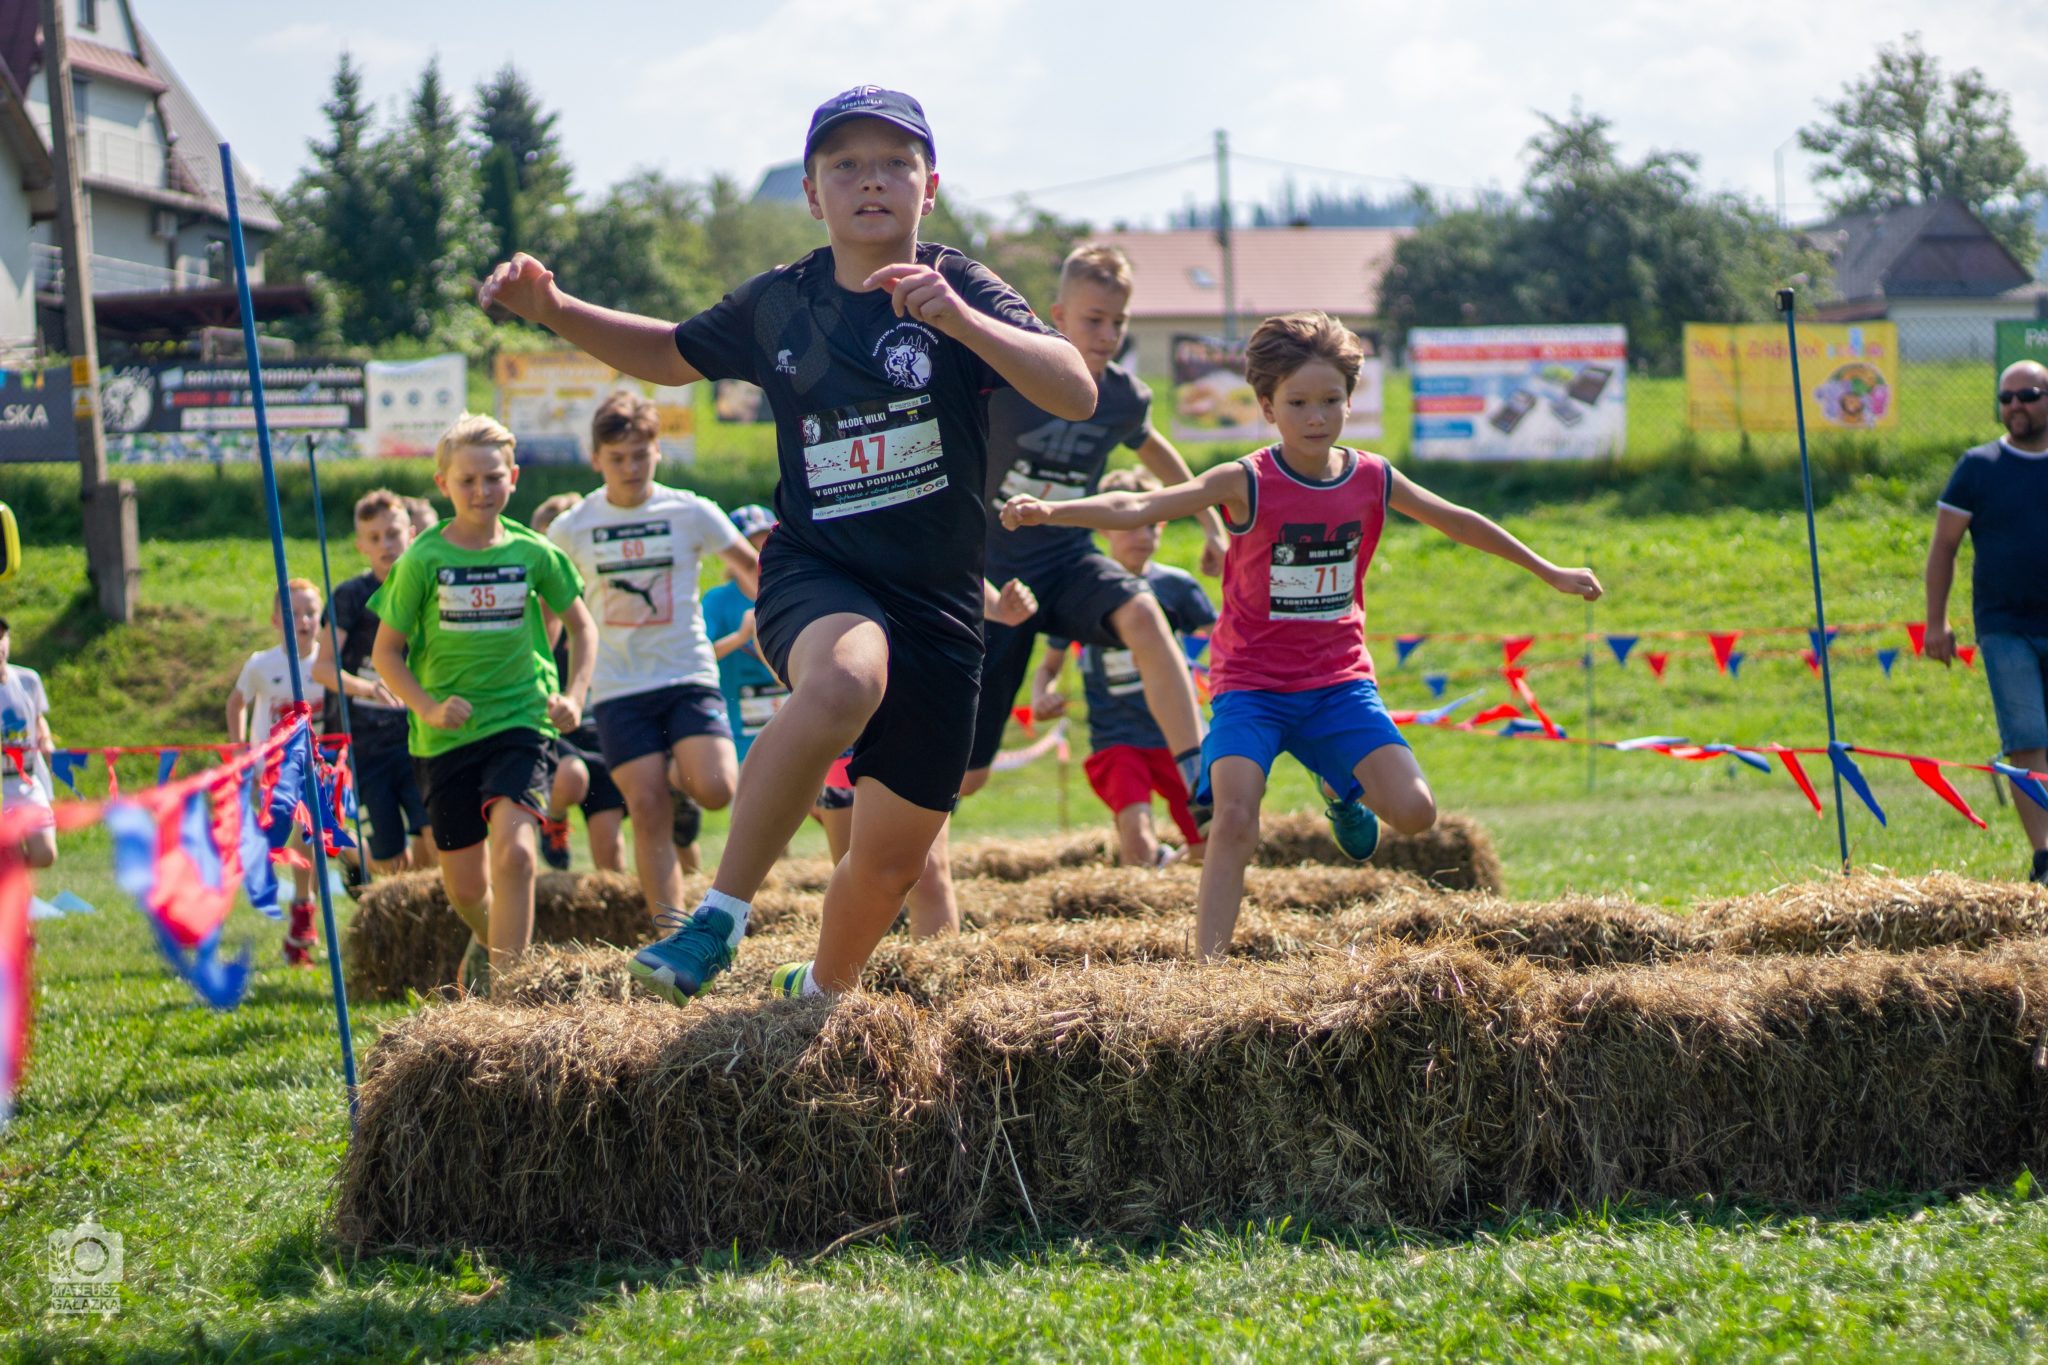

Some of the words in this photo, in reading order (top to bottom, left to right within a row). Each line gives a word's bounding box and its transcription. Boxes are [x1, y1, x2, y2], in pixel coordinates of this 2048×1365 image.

[837, 415, 864, 430] MŁODE
[865, 411, 887, 425] WILKI
[849, 434, 886, 475] 47
[815, 489, 821, 497] V
[822, 481, 864, 496] GONITWA
[866, 460, 939, 488] PODHALAŃSKA
[622, 538, 645, 560] 60
[1314, 565, 1338, 594] 71
[469, 585, 496, 609] 35
[1283, 597, 1320, 606] GONITWA
